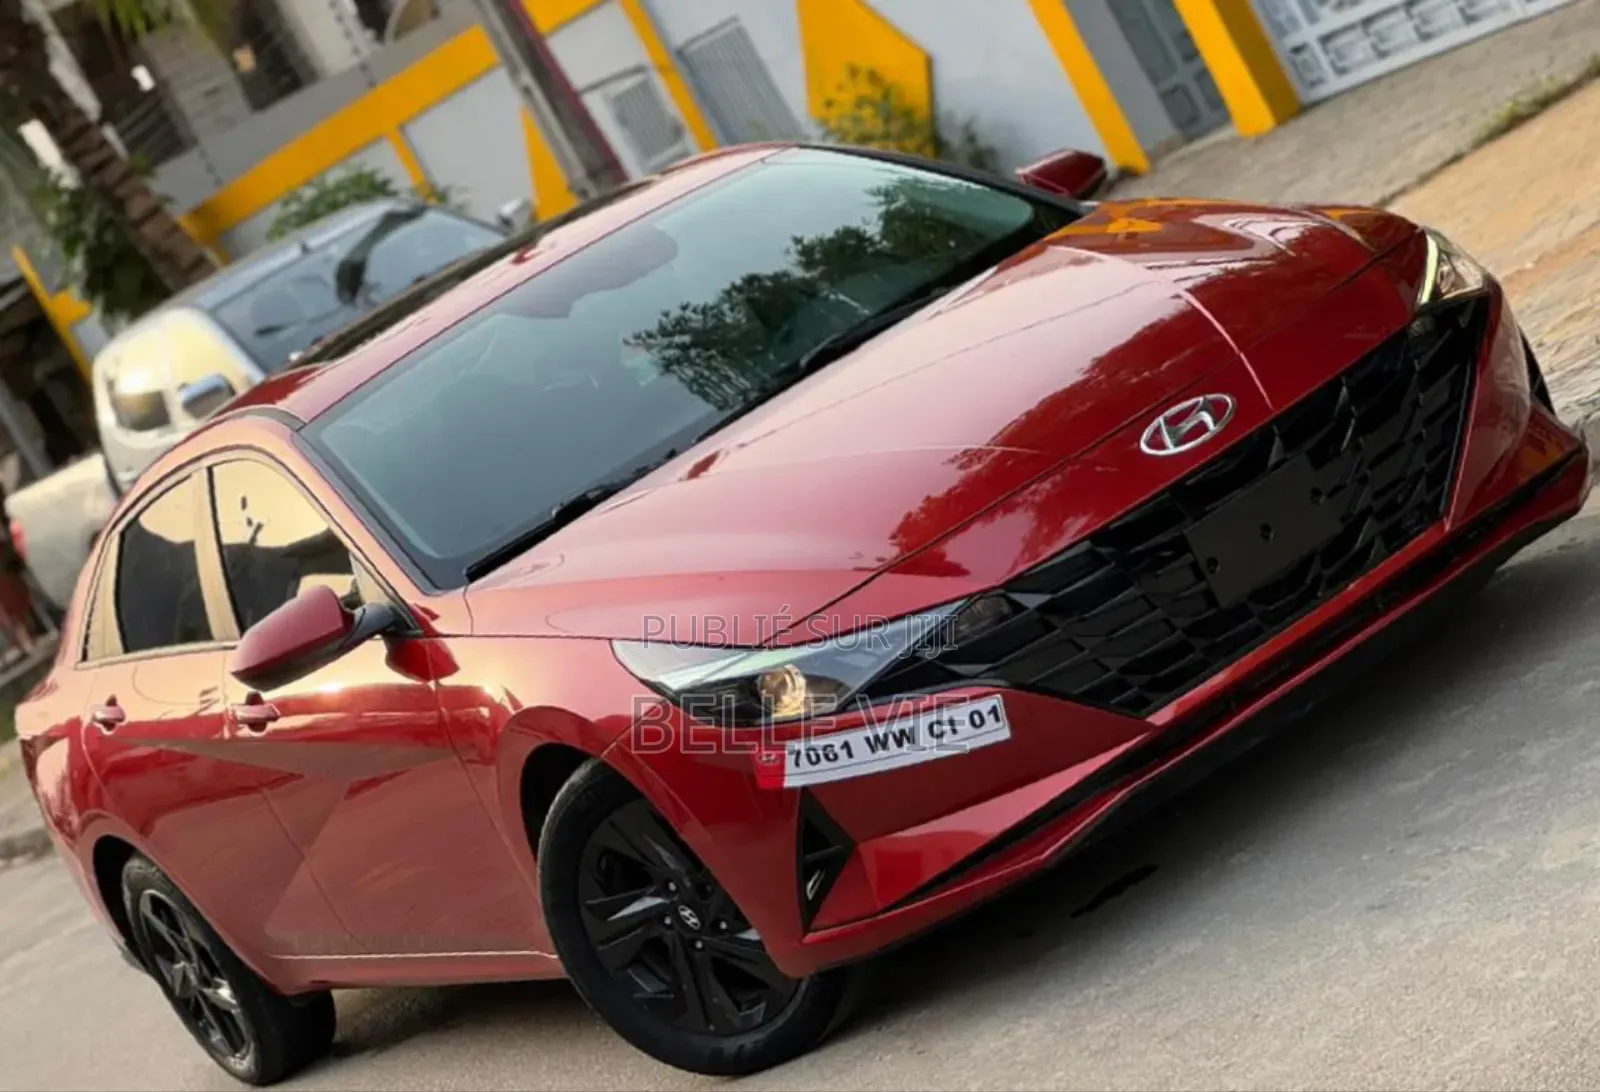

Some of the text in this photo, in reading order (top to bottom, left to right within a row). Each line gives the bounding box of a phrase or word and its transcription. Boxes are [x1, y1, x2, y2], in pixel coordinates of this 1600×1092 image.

[788, 740, 854, 768] 7061
[864, 726, 916, 754] WW
[968, 704, 1001, 730] 01
